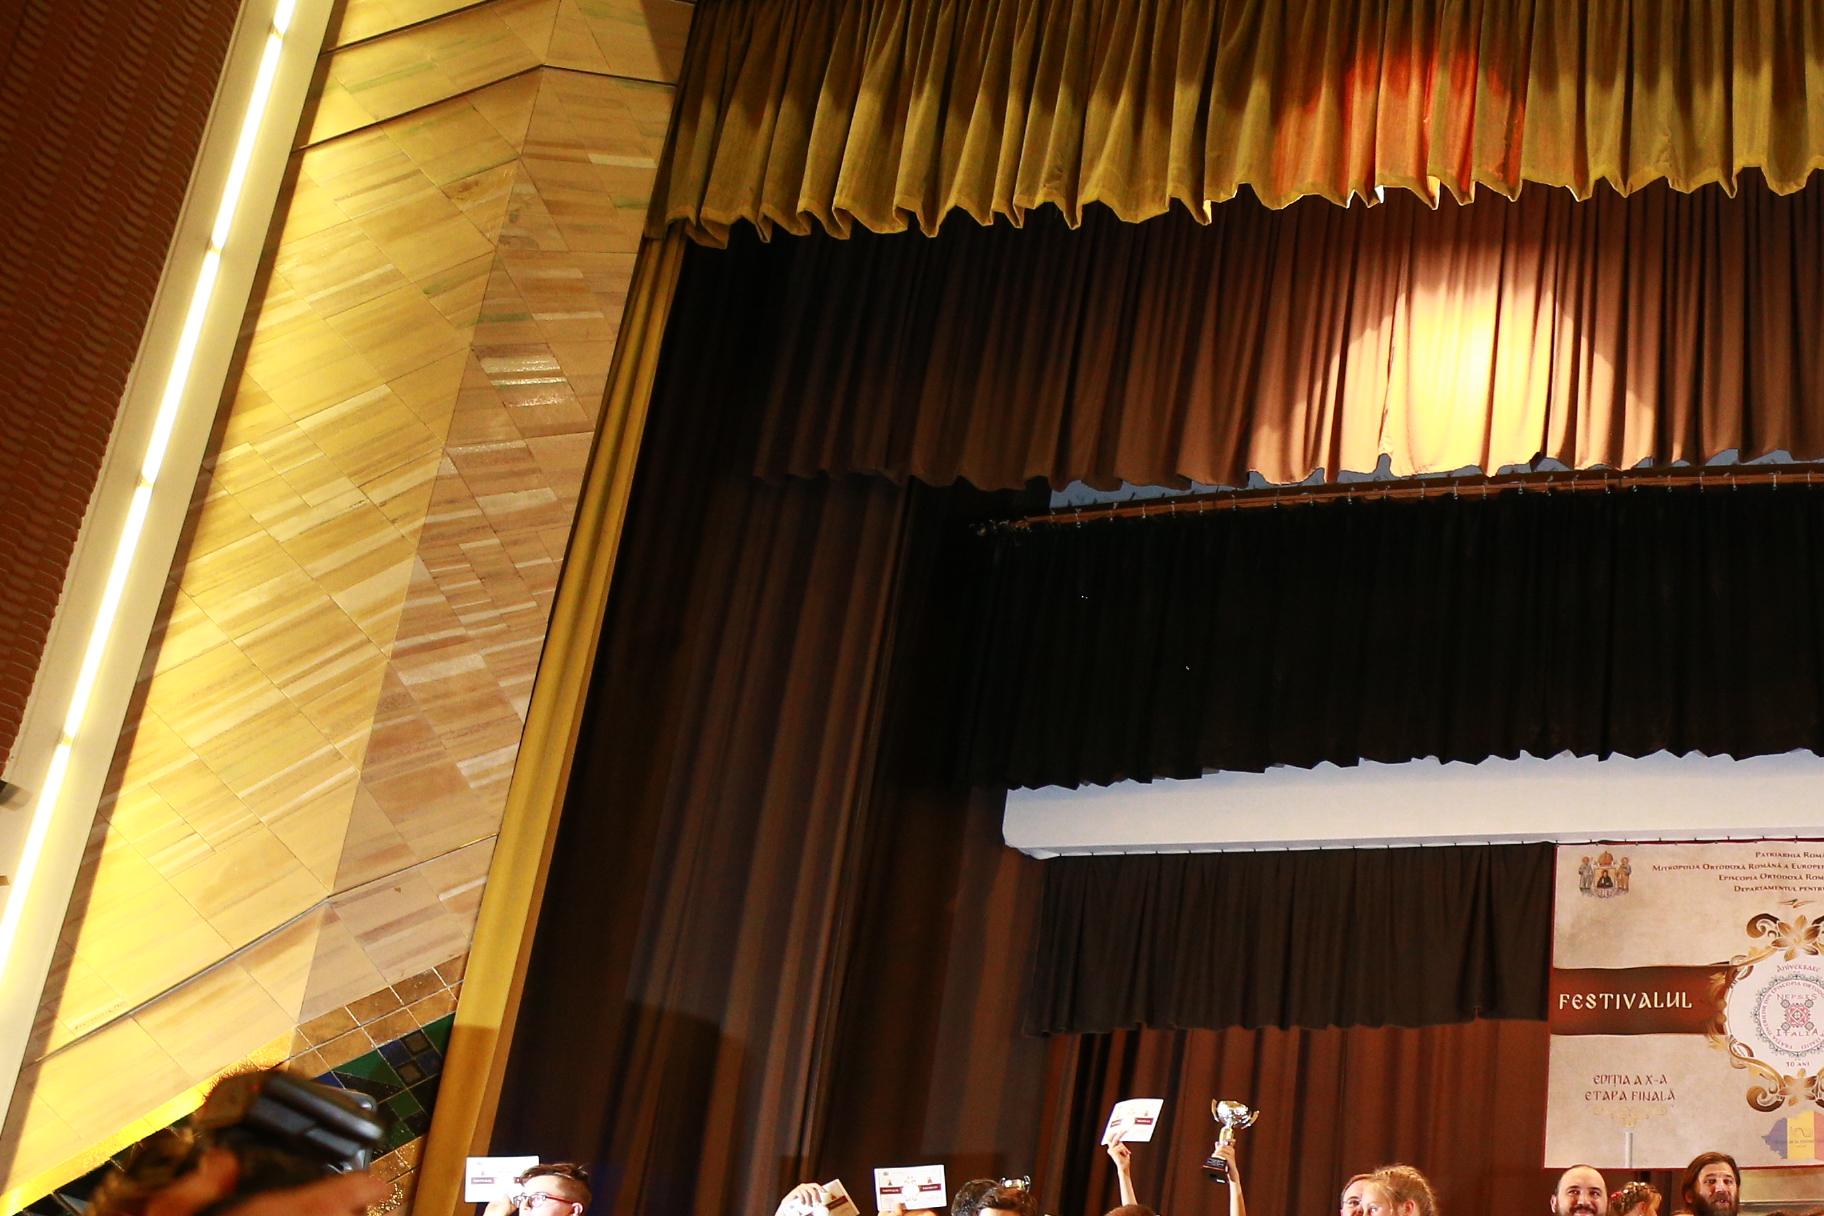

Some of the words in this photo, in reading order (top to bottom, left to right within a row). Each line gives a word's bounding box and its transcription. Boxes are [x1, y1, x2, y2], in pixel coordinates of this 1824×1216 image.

[1559, 991, 1693, 1010] FESTIVALUL
[1776, 993, 1818, 1001] NEPSIS
[1776, 1028, 1819, 1037] ITALIA
[1633, 1075, 1643, 1085] A
[1645, 1074, 1668, 1085] X-A
[1584, 1090, 1628, 1101] ETAPA
